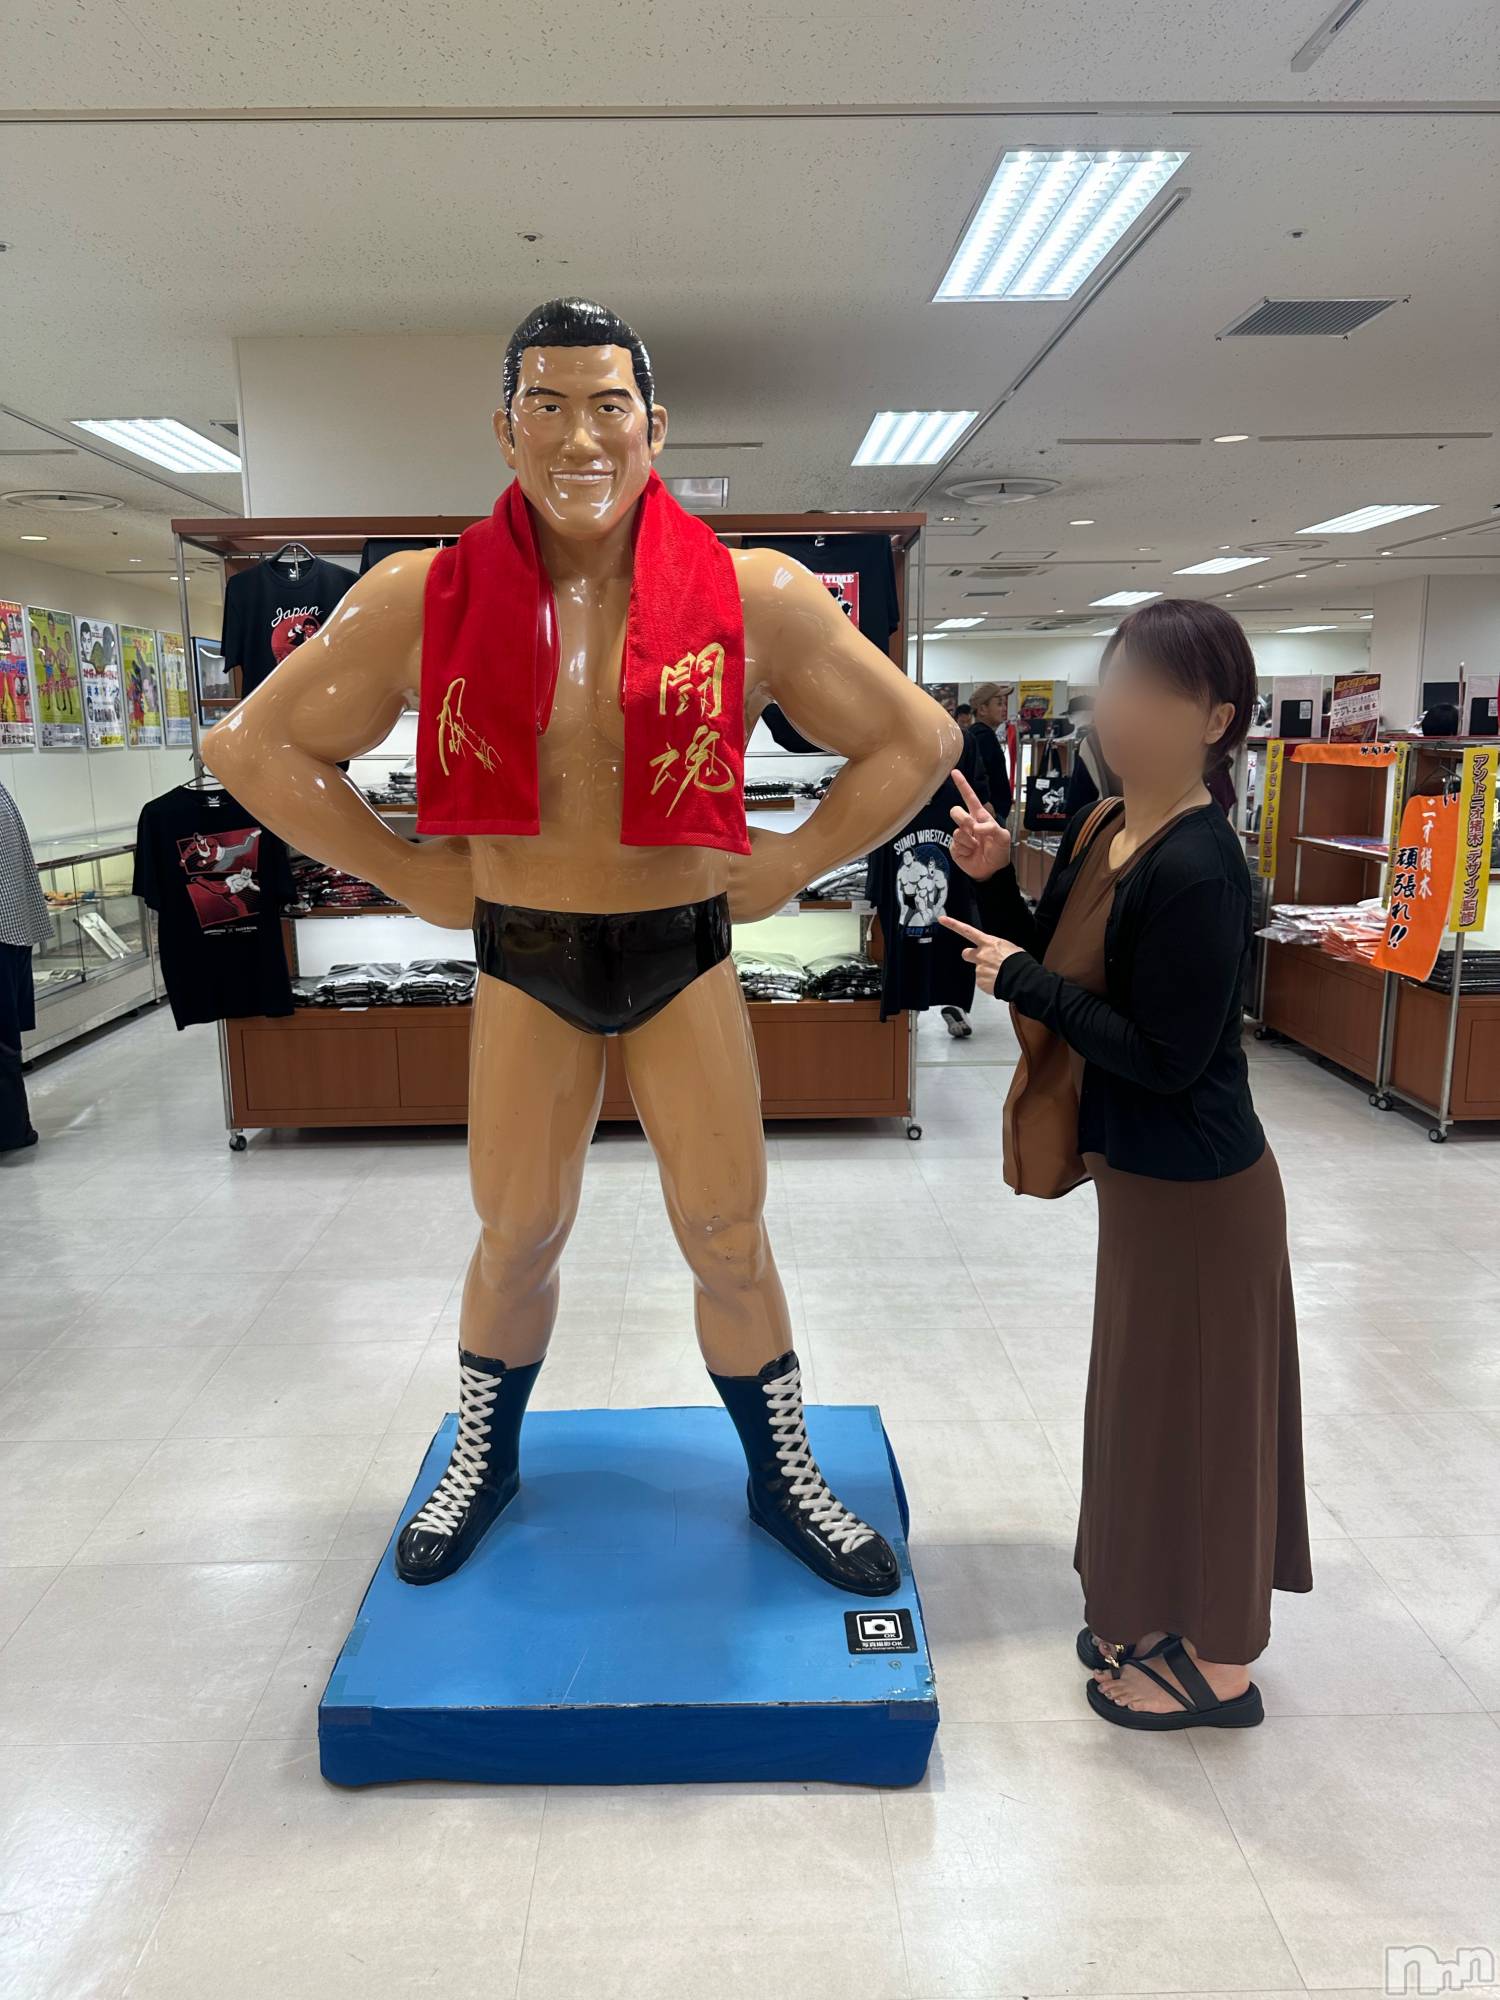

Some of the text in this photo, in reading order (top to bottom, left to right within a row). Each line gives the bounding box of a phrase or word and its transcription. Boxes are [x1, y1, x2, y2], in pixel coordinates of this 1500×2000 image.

[271, 605, 324, 628] Japan
[649, 642, 736, 818] 闘魂
[893, 832, 917, 856] SUMO
[1459, 754, 1489, 927] アントニオ猪木 デザイン監修
